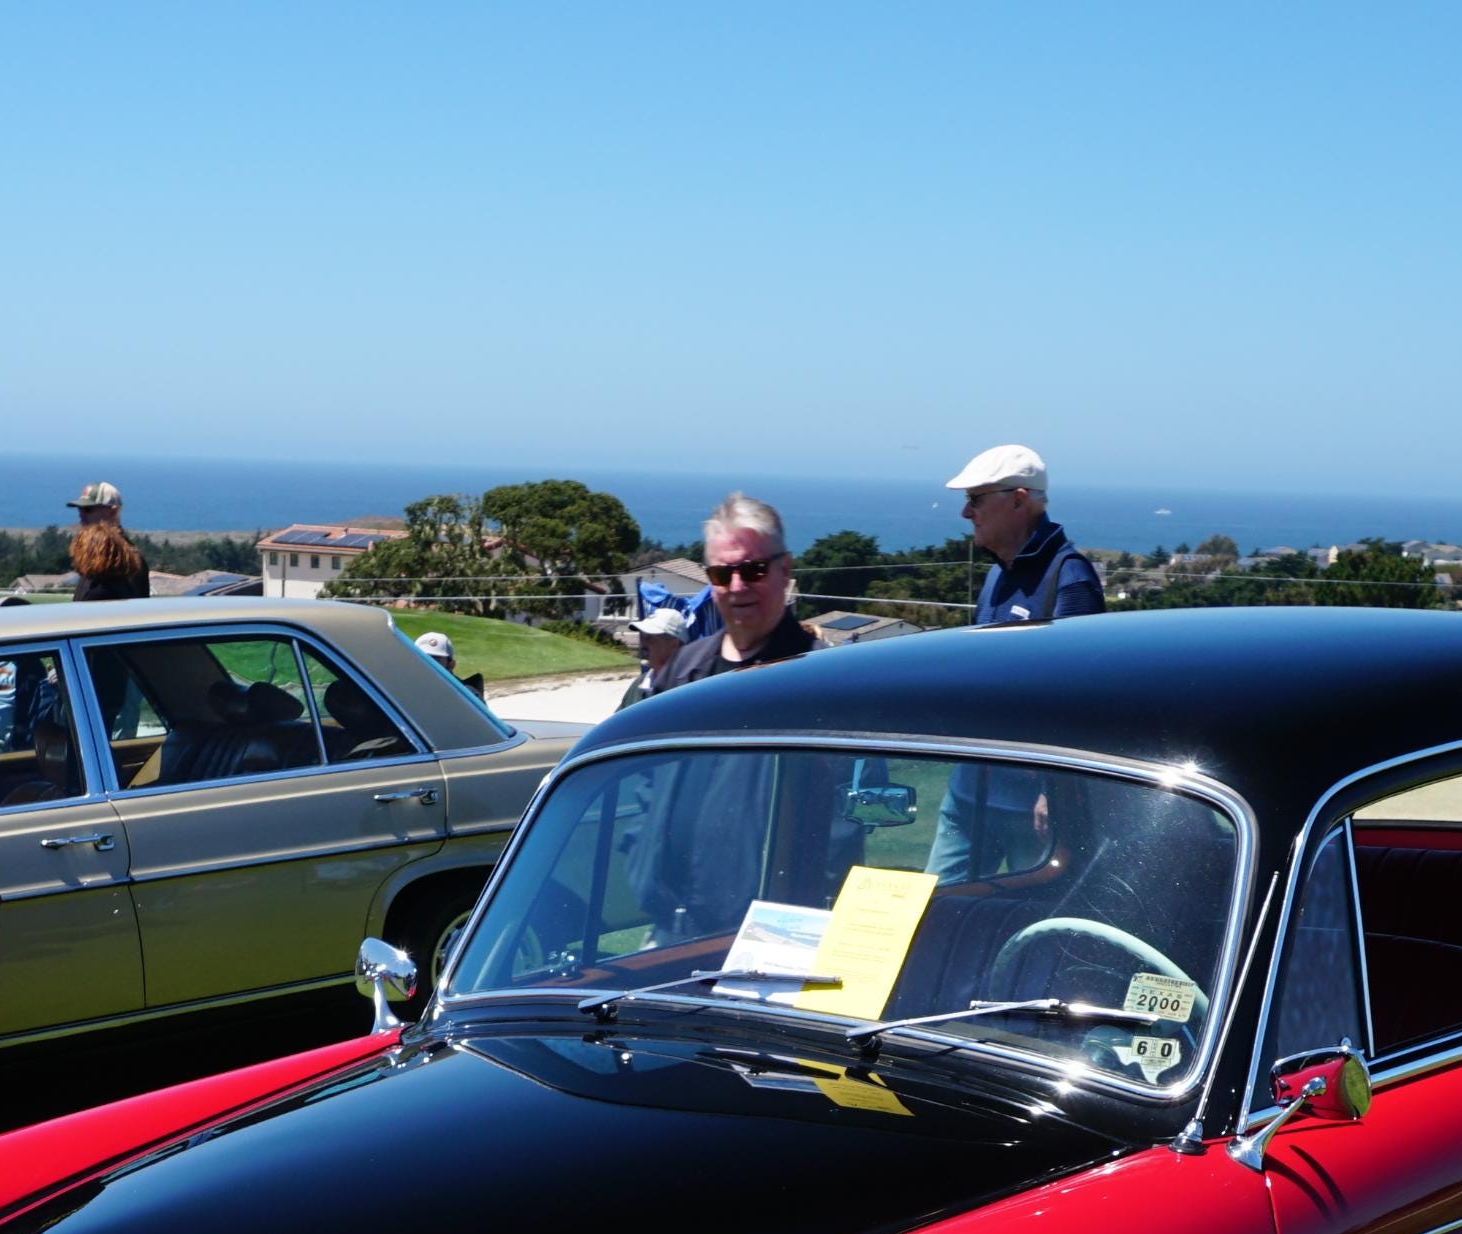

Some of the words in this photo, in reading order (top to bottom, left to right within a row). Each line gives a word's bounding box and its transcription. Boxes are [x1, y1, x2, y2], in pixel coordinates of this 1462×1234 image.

[1141, 988, 1182, 999] TEXAS
[1137, 994, 1180, 1011] 2000
[1137, 1041, 1148, 1055] 6
[1160, 1042, 1173, 1057] 0
